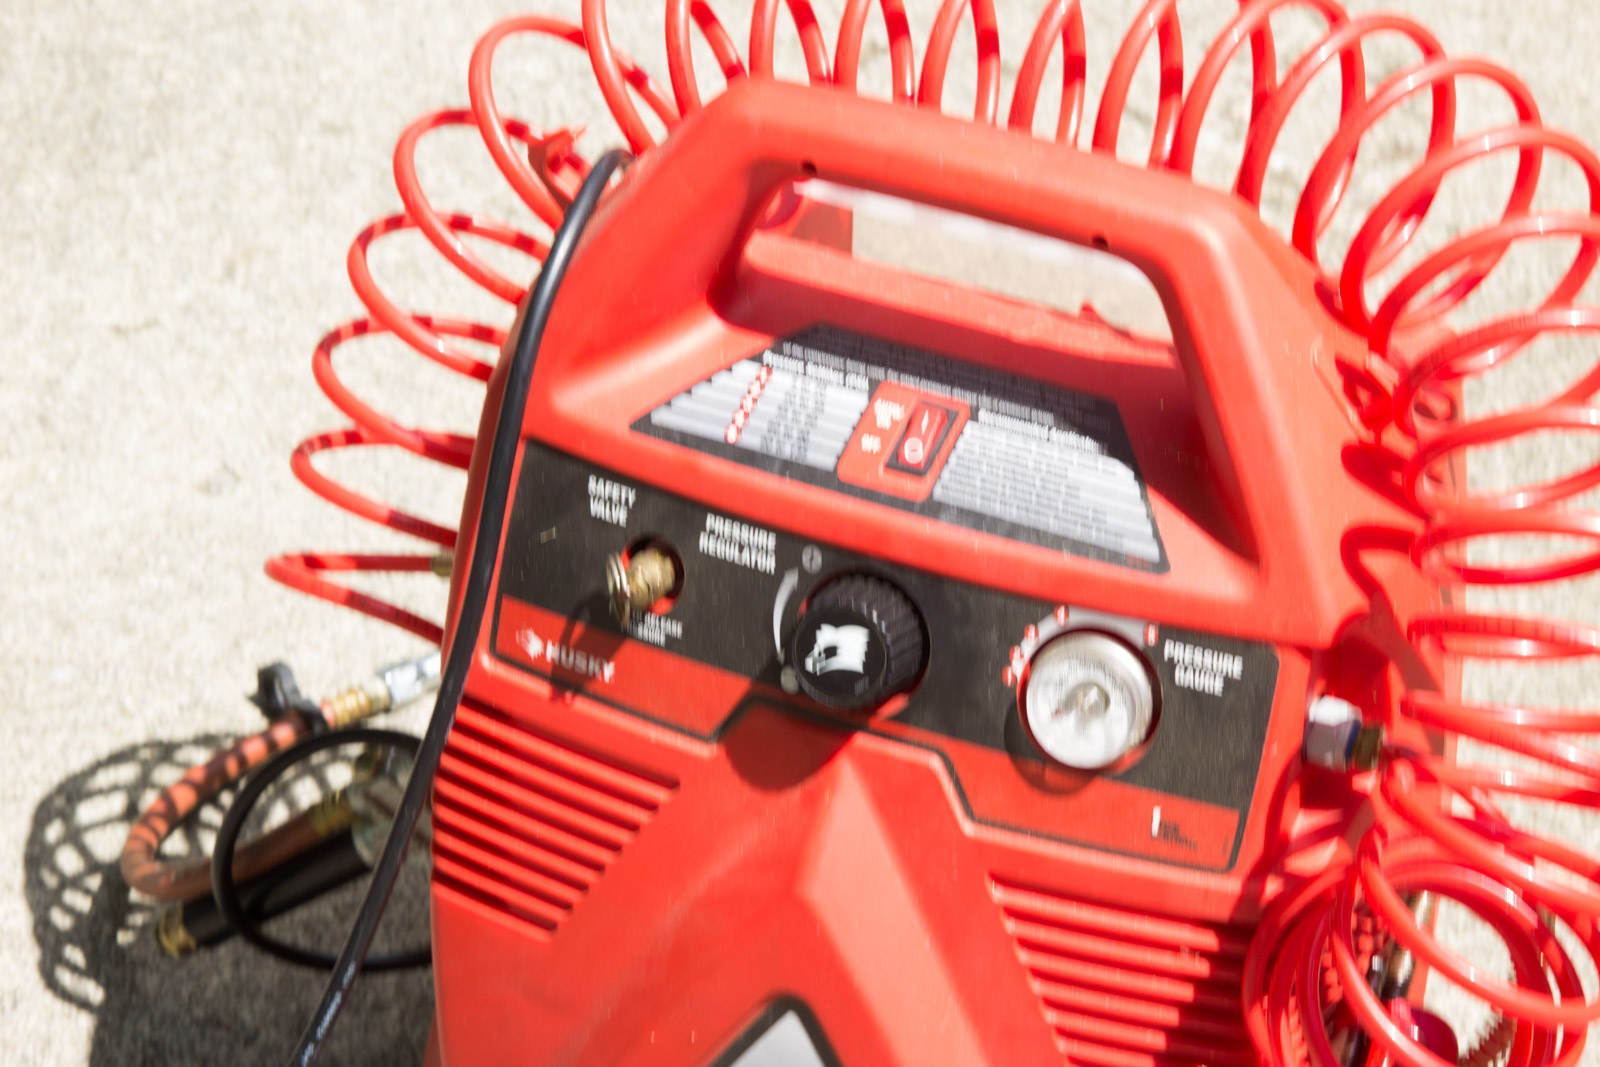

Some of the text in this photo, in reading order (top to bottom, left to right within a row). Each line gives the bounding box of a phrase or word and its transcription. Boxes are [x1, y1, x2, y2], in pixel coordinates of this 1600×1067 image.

[588, 474, 636, 509] SAFETY
[590, 496, 628, 528] VALVE
[706, 512, 776, 551] PRESSURE
[699, 531, 776, 576] REGULATOR
[546, 640, 615, 684] HUSKY
[1164, 638, 1243, 680] PRESSURE
[1175, 663, 1224, 696] GAUGE
